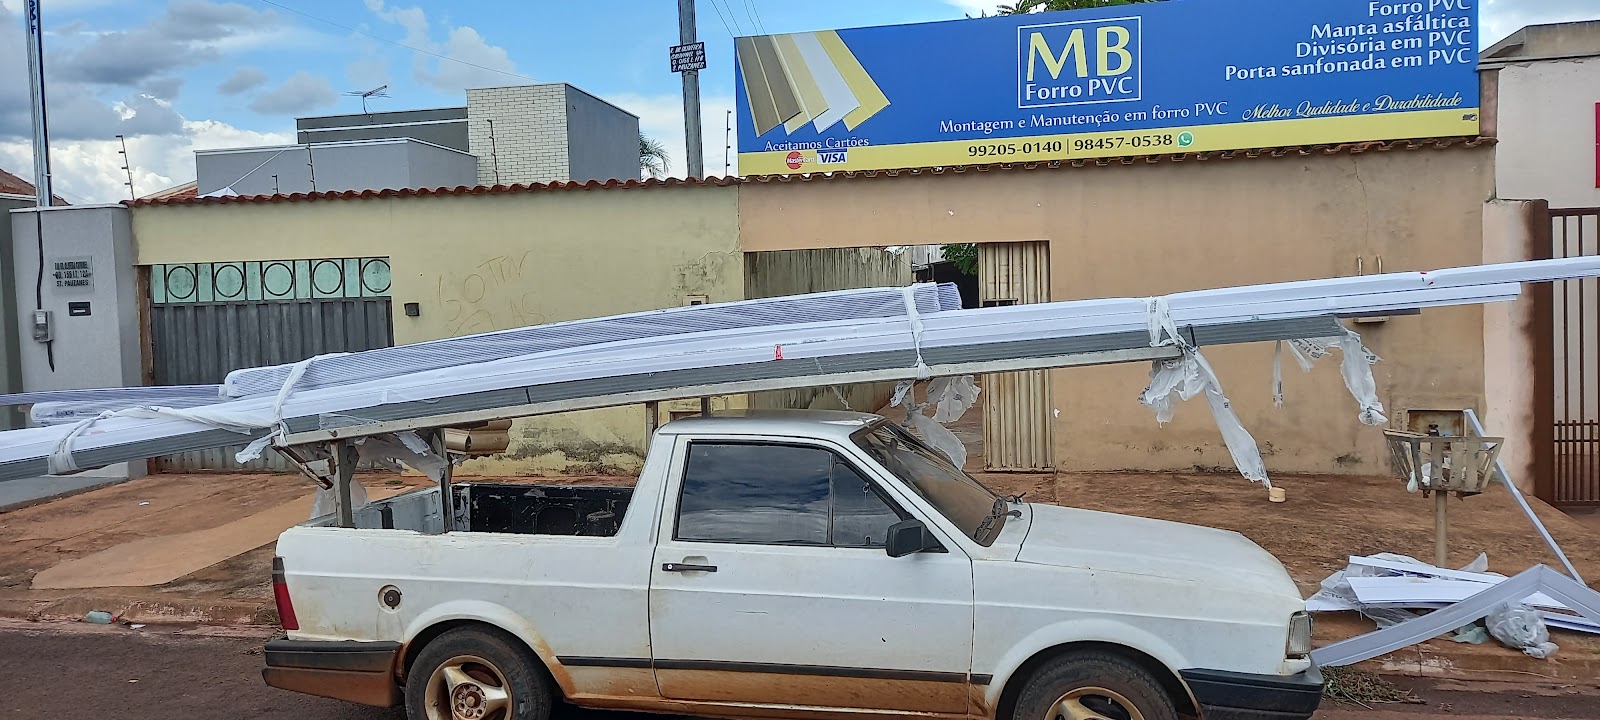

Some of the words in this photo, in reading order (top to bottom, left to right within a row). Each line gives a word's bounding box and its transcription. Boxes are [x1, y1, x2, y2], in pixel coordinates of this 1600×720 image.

[1369, 0, 1423, 17] Forro
[1428, 0, 1472, 12] PVC
[1310, 22, 1378, 40] Manta
[1382, 13, 1471, 34] asfáltica
[1026, 26, 1132, 81] MB
[1295, 36, 1387, 58] Divisória
[1391, 36, 1422, 50] em
[1428, 29, 1472, 48] PVC
[1224, 64, 1278, 81] Porta
[1281, 53, 1387, 77] sanfonada
[1391, 54, 1422, 68] em
[1428, 47, 1472, 66] PVC
[1026, 83, 1082, 101] Forro
[1088, 76, 1133, 96] PVC
[939, 117, 1014, 135] Montagem
[1018, 118, 1026, 128] e
[1030, 110, 1120, 128] Manutenção
[1124, 110, 1147, 122] em
[1151, 104, 1190, 120] forro
[1195, 101, 1229, 117] PVC
[1242, 102, 1293, 121] Melhor
[1296, 98, 1360, 118] Qualidade
[1362, 102, 1371, 112] e
[1372, 91, 1463, 112] Durabilidade
[764, 140, 822, 152] Aceitamos
[825, 136, 870, 149] Cartões
[968, 140, 1062, 157] 99205-0140
[1074, 133, 1173, 151] 98457-0538
[820, 152, 846, 164] VISA
